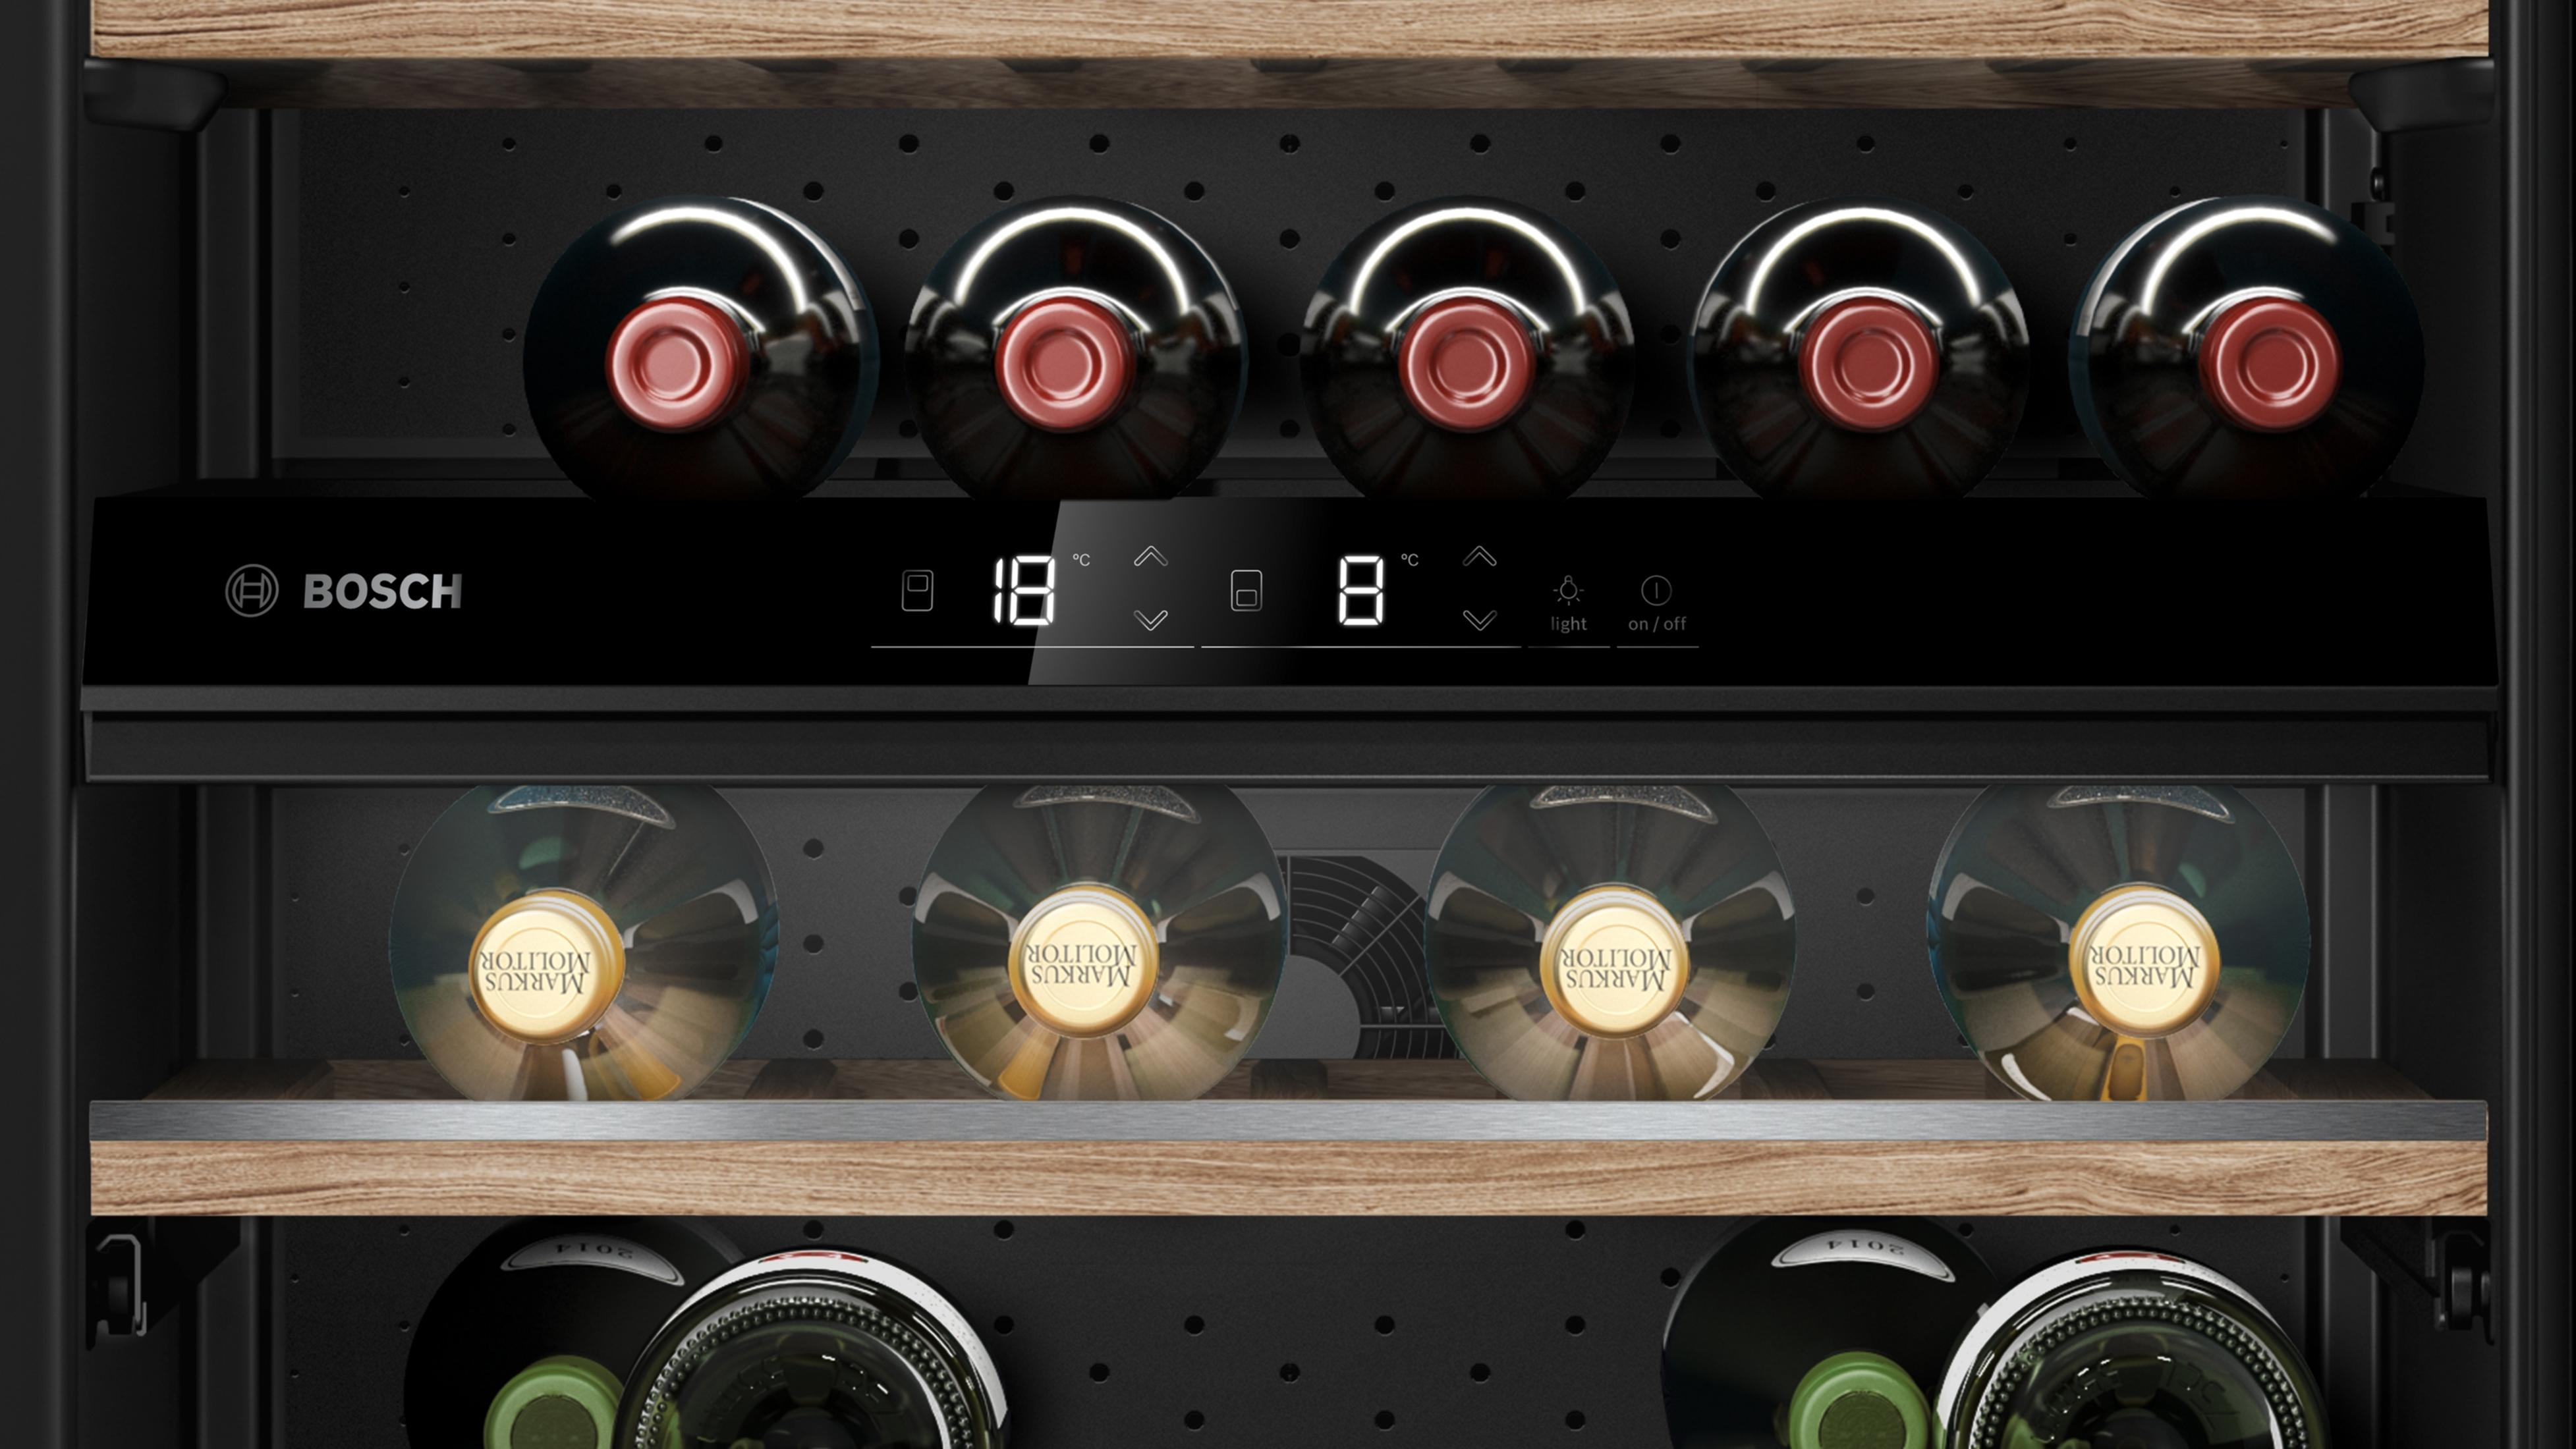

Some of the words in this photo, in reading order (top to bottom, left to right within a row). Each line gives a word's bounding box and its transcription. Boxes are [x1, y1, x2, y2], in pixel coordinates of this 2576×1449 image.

[304, 572, 462, 610] BOSCH
[995, 556, 1055, 626] 18
[1073, 553, 1090, 566] °C
[1339, 556, 1384, 626] 8
[1401, 553, 1418, 566] °C
[1551, 616, 1588, 634] light
[1628, 620, 1648, 631] on
[1664, 616, 1687, 631] off
[480, 951, 591, 973] MOLITOR
[1026, 944, 1138, 967] MOLITOR
[1561, 948, 1672, 971] MOLITOR
[2090, 945, 2201, 968] MOLITOR
[486, 972, 584, 995] MARKUS
[1032, 966, 1129, 987] MARKUS
[1567, 970, 1664, 992] MARKUS
[2095, 966, 2193, 989] MARKUS
[557, 1242, 633, 1259] 2014
[1828, 1240, 1904, 1255] 2014
